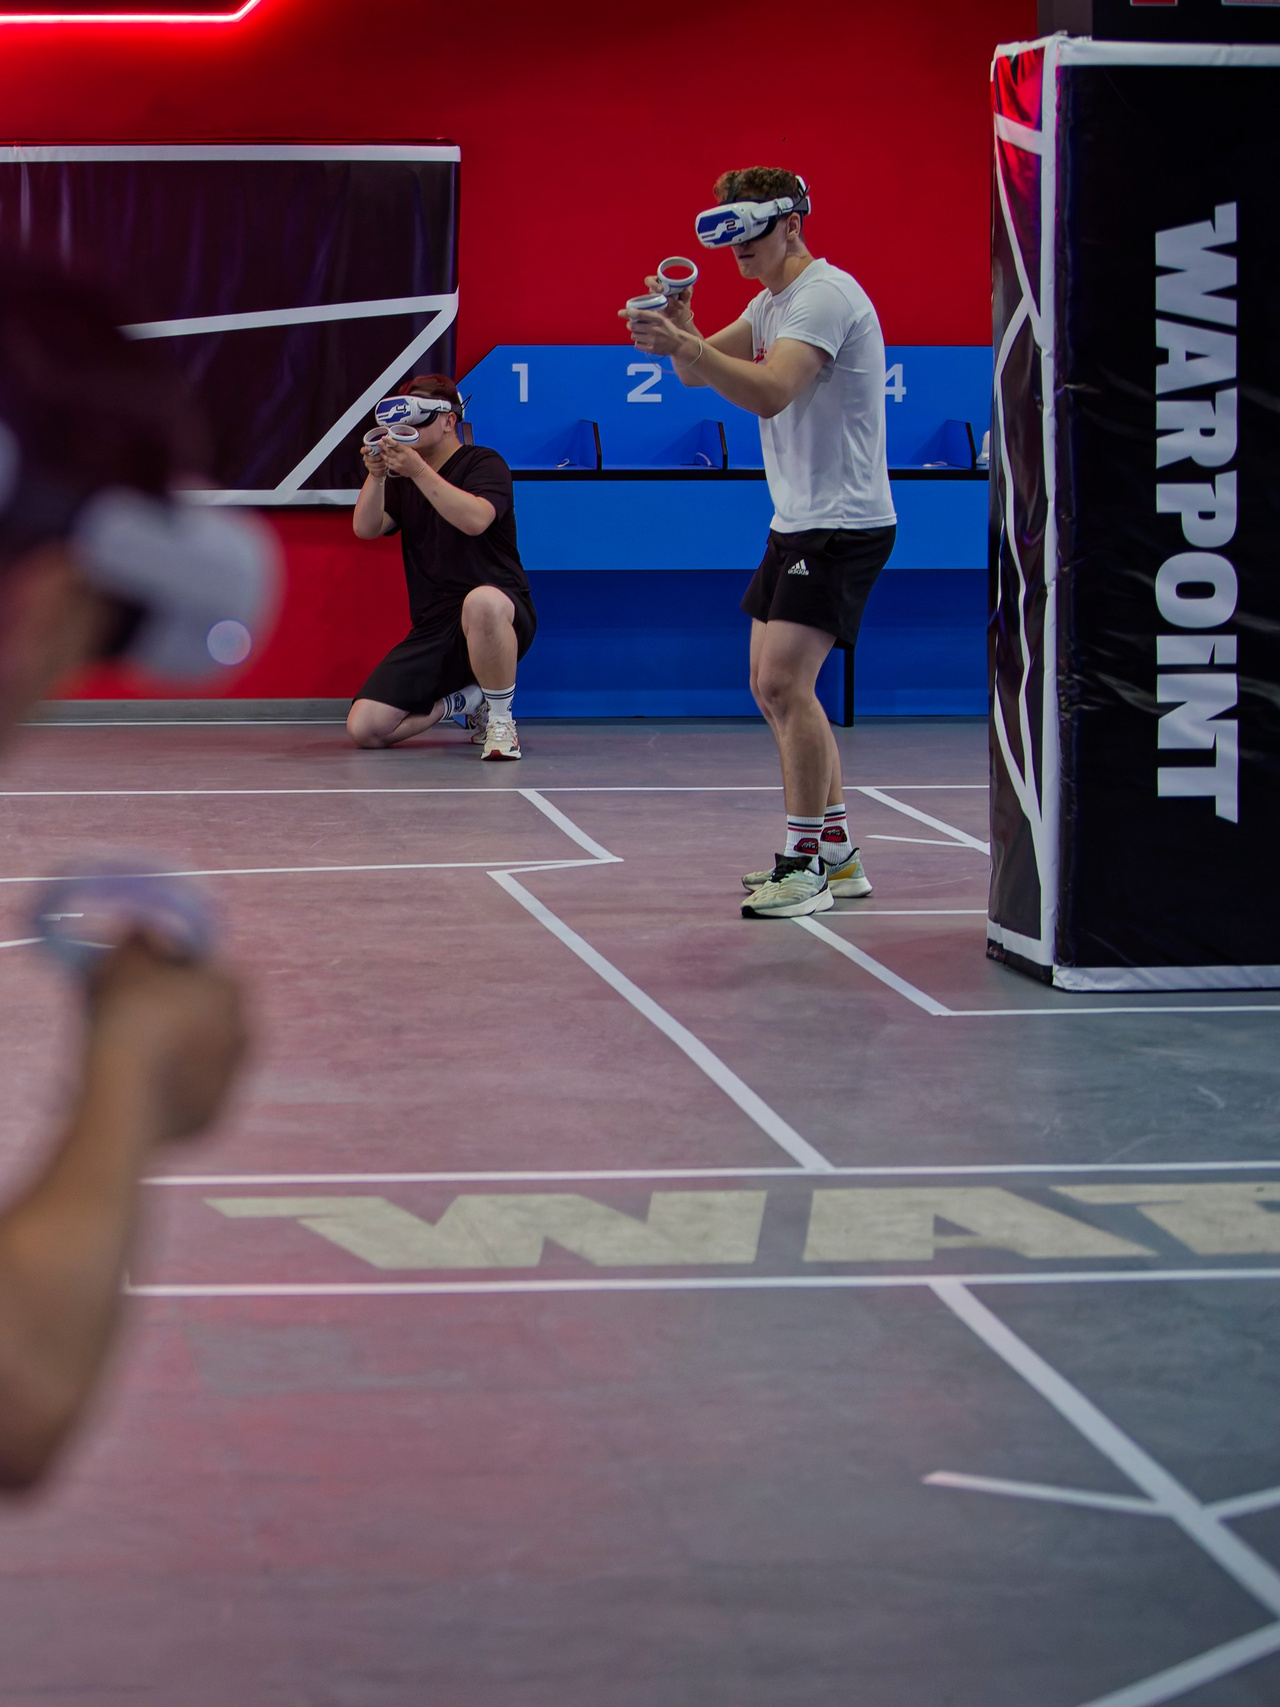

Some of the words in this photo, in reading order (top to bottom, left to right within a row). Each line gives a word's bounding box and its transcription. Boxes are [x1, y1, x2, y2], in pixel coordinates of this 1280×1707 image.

[725, 218, 737, 231] 2
[511, 363, 529, 403] 1
[626, 363, 663, 403] 2
[884, 363, 907, 403] 4
